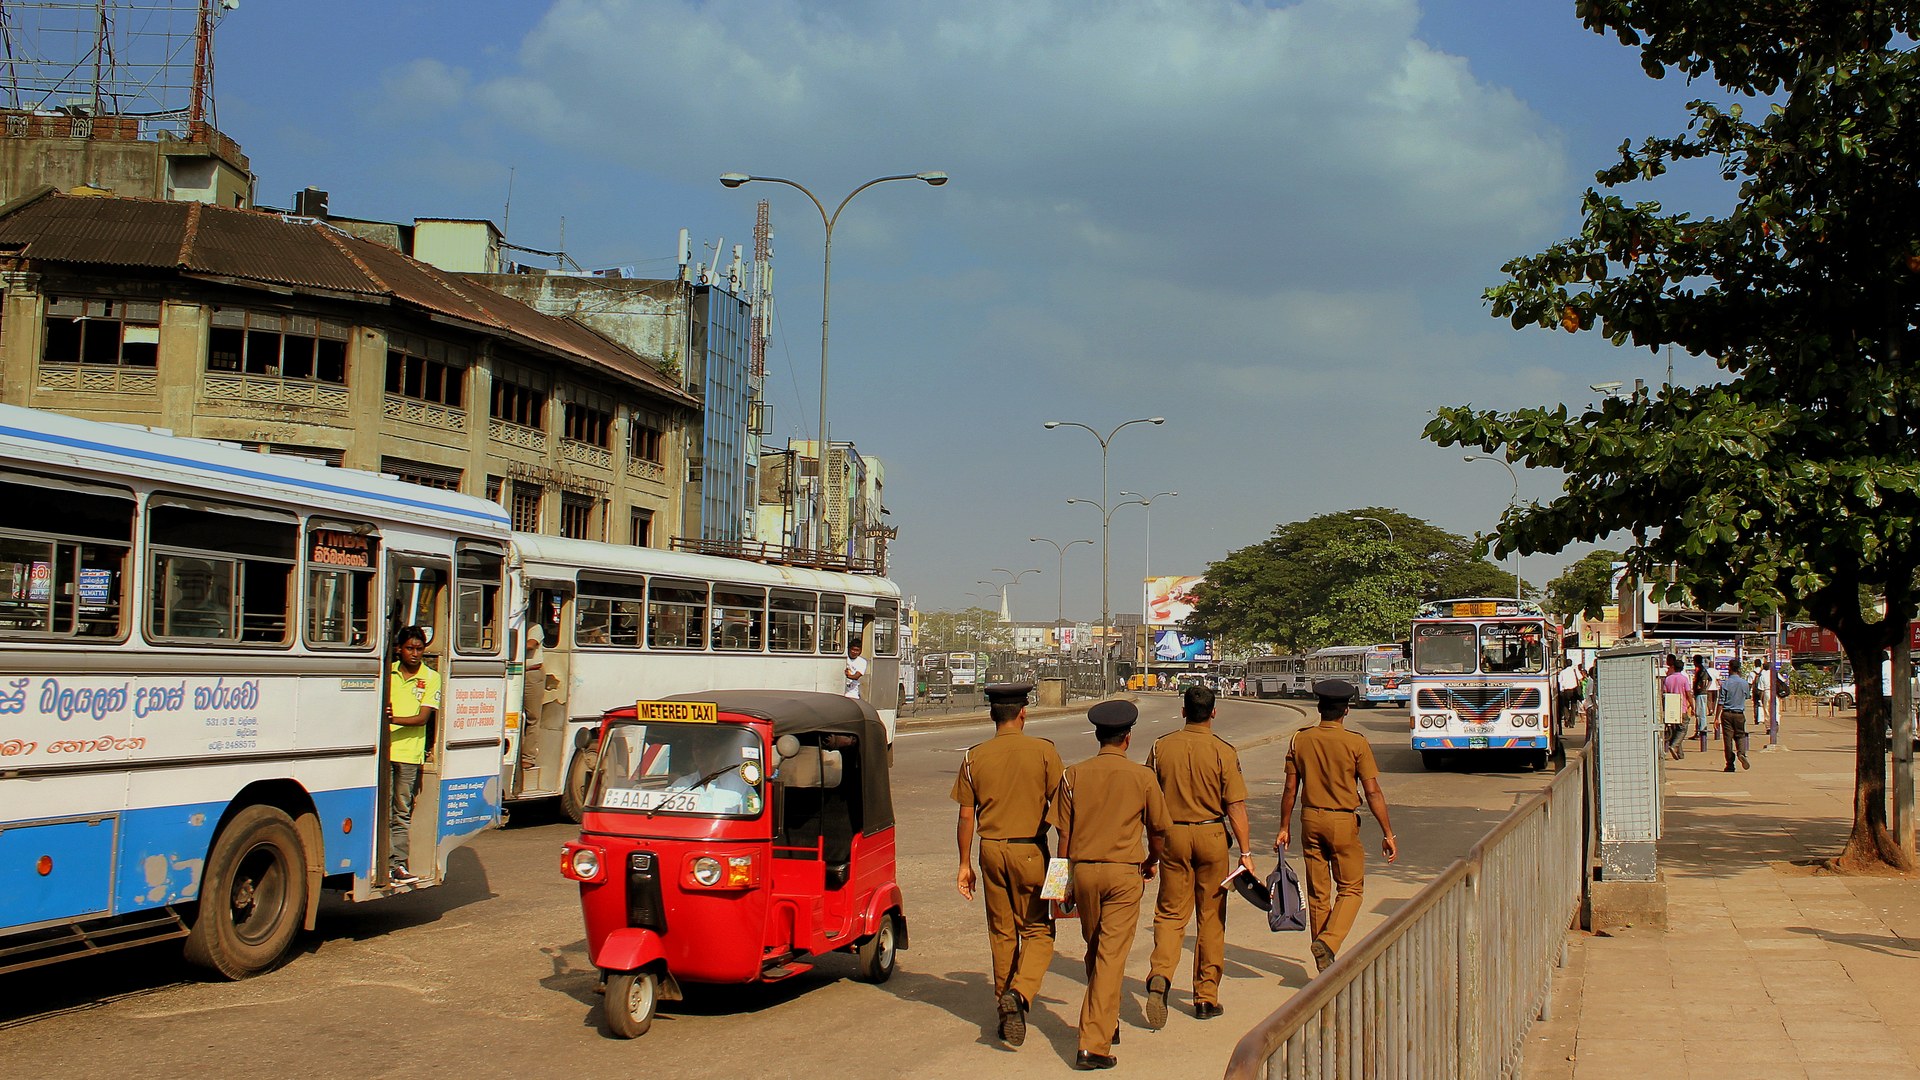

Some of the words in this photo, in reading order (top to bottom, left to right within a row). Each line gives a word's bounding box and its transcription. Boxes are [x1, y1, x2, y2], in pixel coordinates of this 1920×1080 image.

[39, 678, 130, 722] බලයලත්
[134, 680, 186, 718] උකස්
[194, 677, 260, 711] කරුවෝ
[641, 703, 688, 720] METERED
[691, 705, 713, 721] TAXI
[46, 735, 146, 754] නොමැත
[620, 791, 650, 808] AAA
